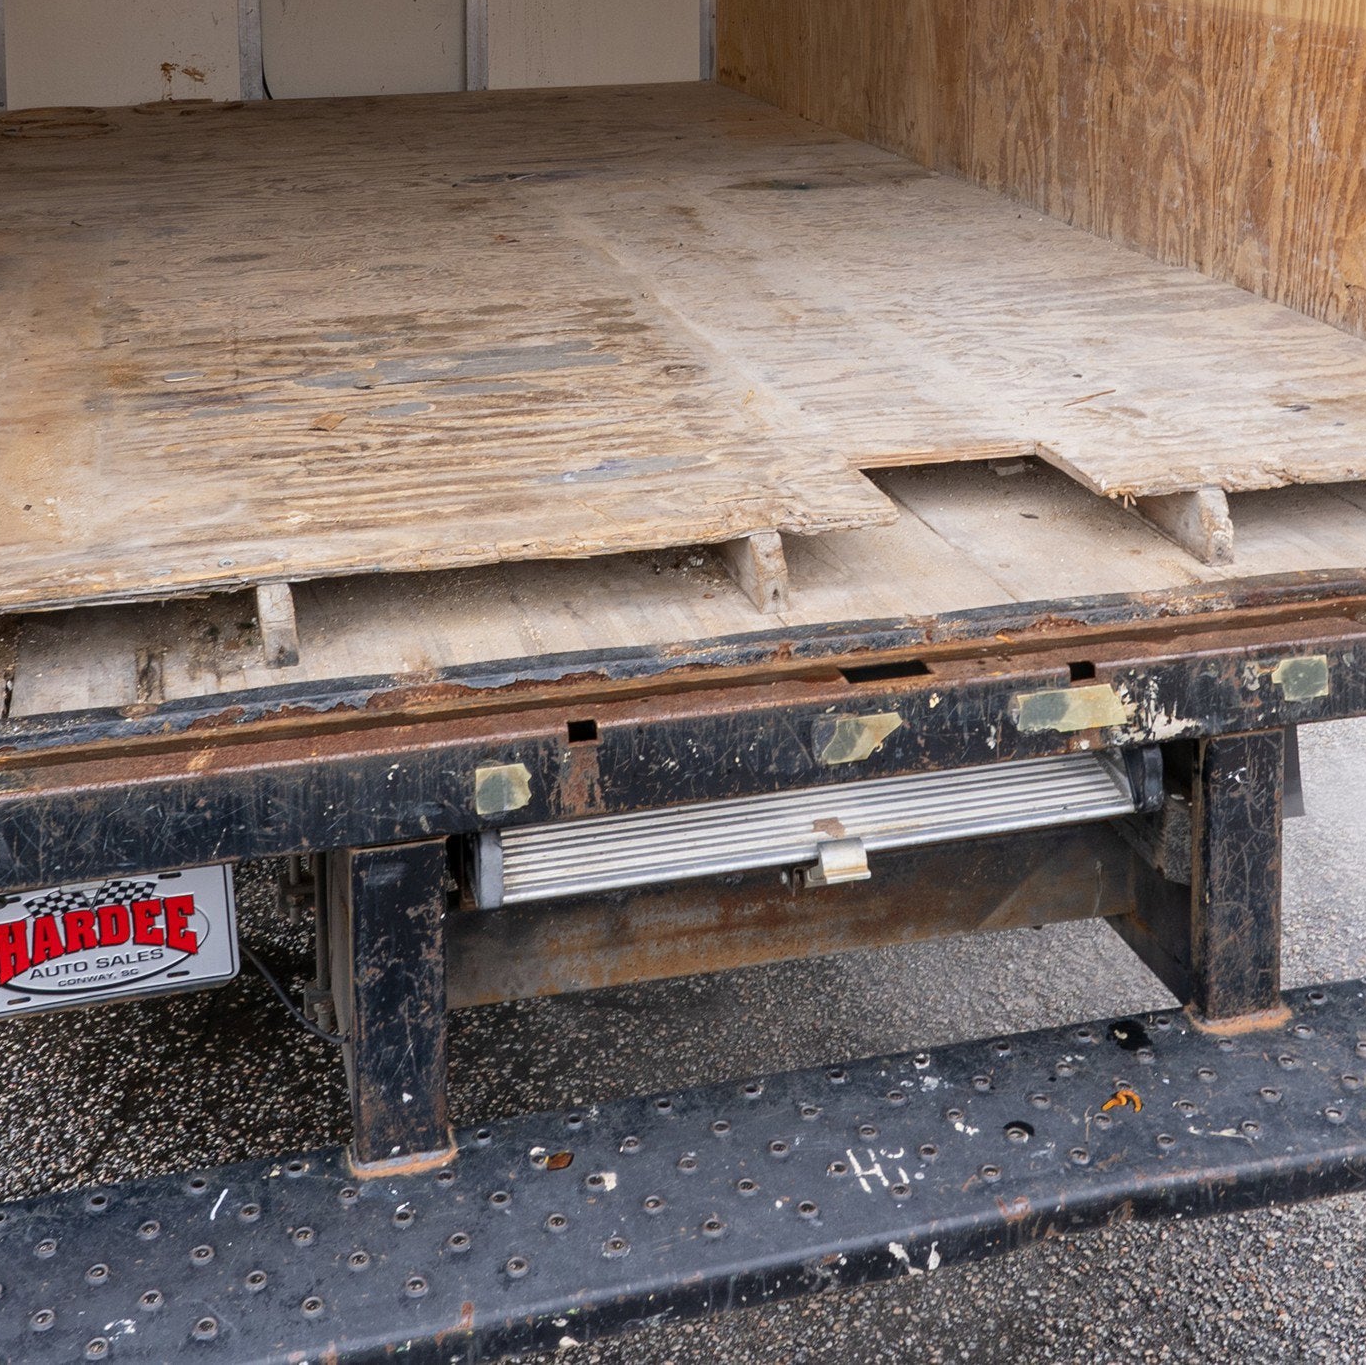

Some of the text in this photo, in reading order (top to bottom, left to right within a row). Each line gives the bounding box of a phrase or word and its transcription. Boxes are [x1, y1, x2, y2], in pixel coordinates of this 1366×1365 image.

[29, 948, 164, 981] AUTO SALES
[57, 967, 139, 987] CONWAY, SC
